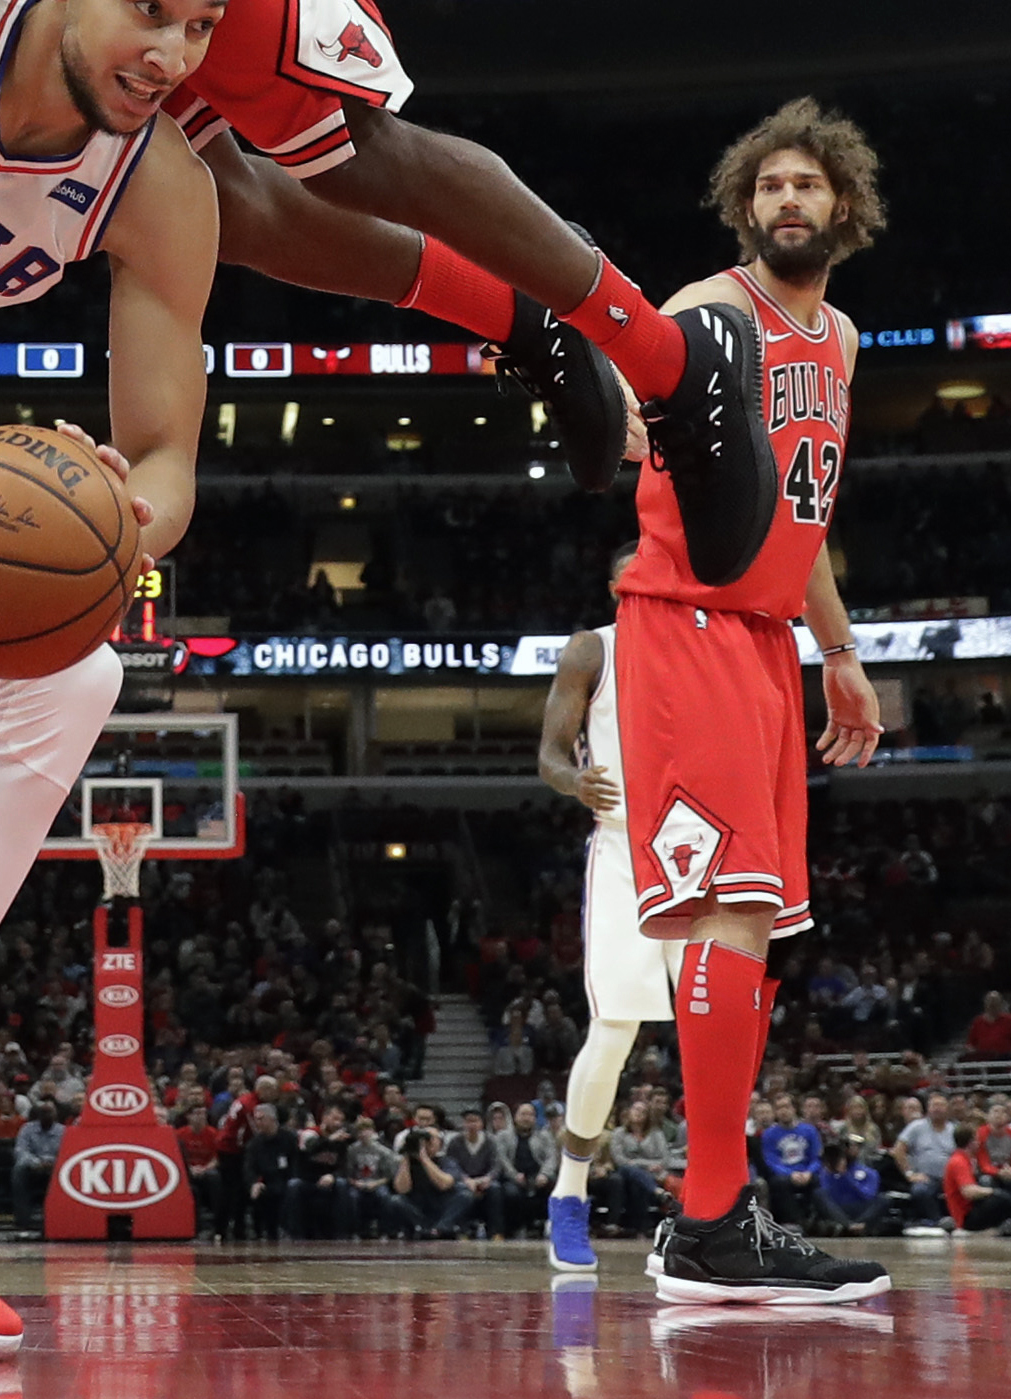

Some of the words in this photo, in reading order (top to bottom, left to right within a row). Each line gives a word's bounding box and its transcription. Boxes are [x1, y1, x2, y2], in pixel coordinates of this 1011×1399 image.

[877, 328, 936, 348] CLUB
[369, 343, 431, 374] BULLS
[768, 361, 850, 440] BULLS
[783, 437, 841, 527] 42
[118, 652, 169, 668] SSOT
[254, 643, 389, 669] CHICAGO
[403, 643, 500, 668] BULLS
[102, 953, 136, 971] ZTE
[99, 1091, 140, 1109] KIA
[80, 1159, 160, 1194] KIA
